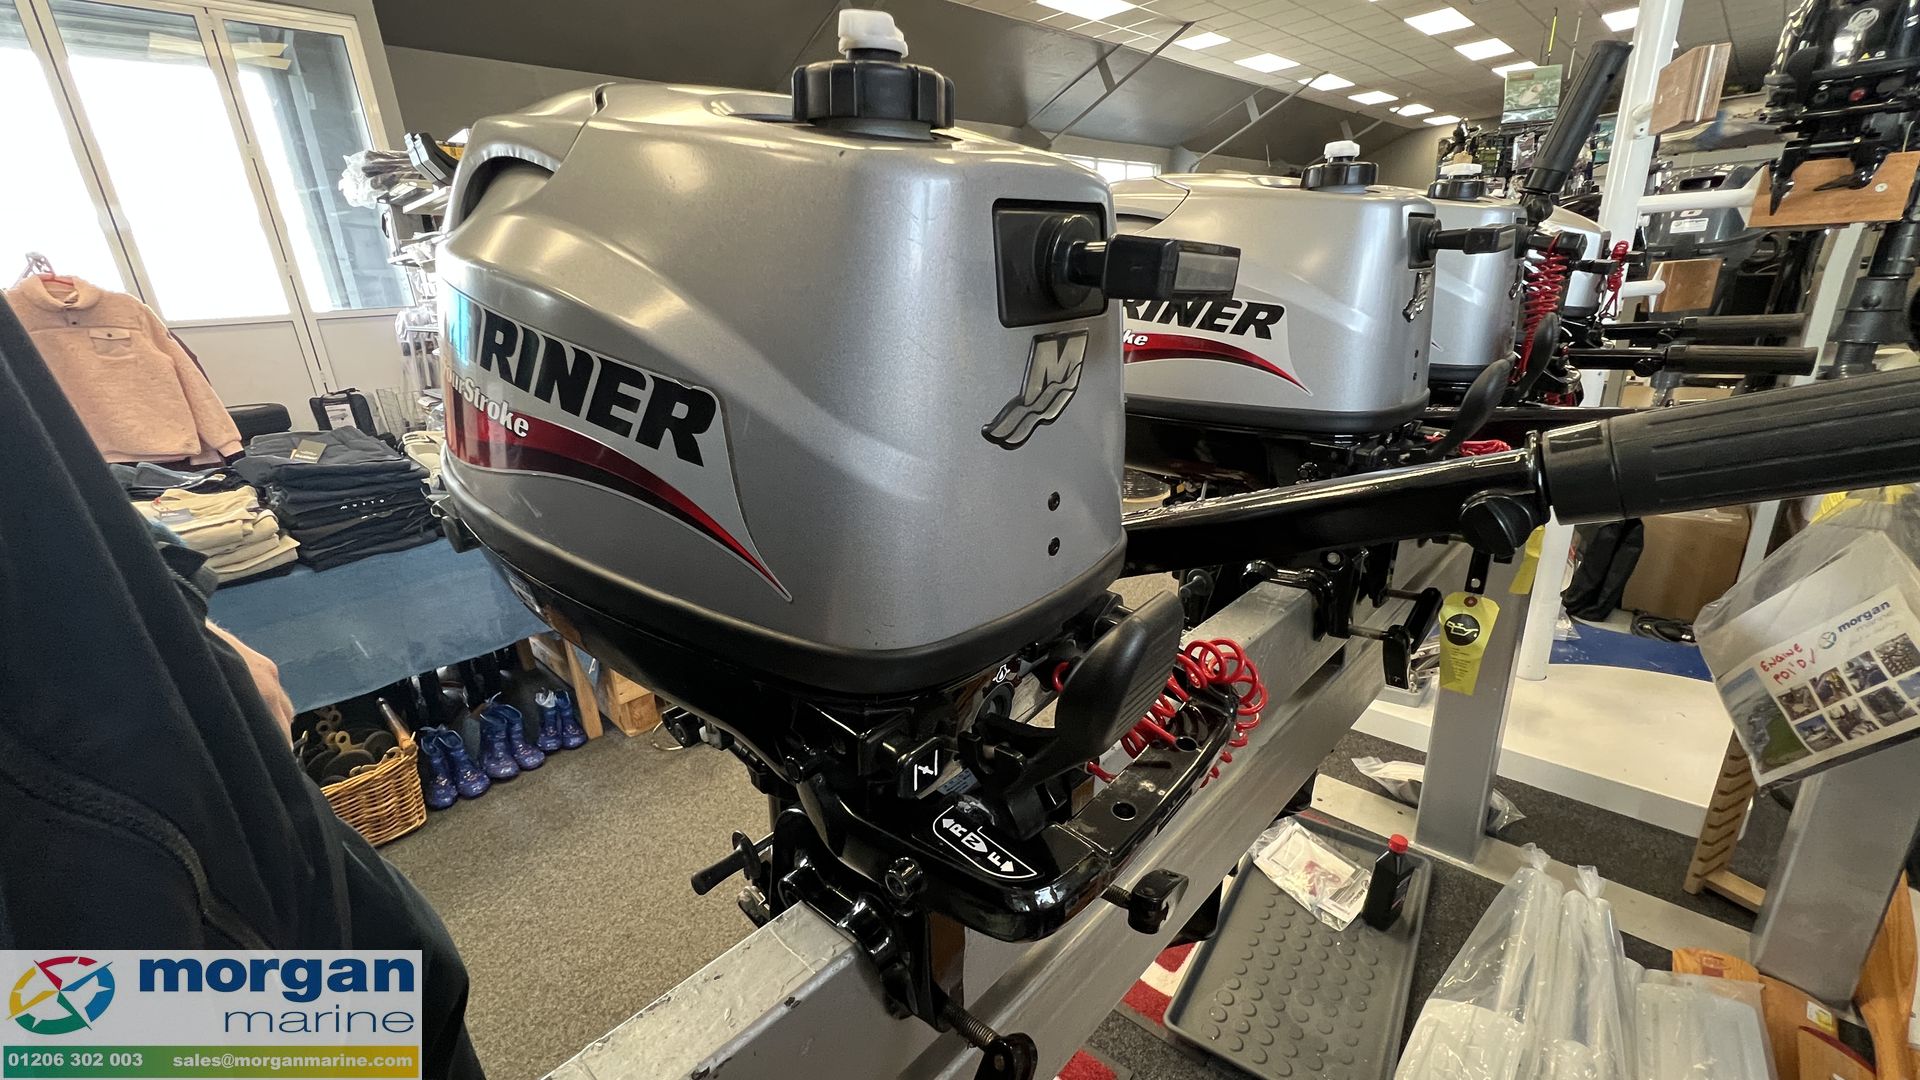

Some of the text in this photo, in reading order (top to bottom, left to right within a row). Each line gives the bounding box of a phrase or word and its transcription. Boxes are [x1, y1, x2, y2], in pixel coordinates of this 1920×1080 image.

[1123, 299, 1285, 340] RINER
[446, 367, 529, 438] ourStroke
[466, 302, 717, 467] RINER
[1838, 601, 1890, 632] morgan
